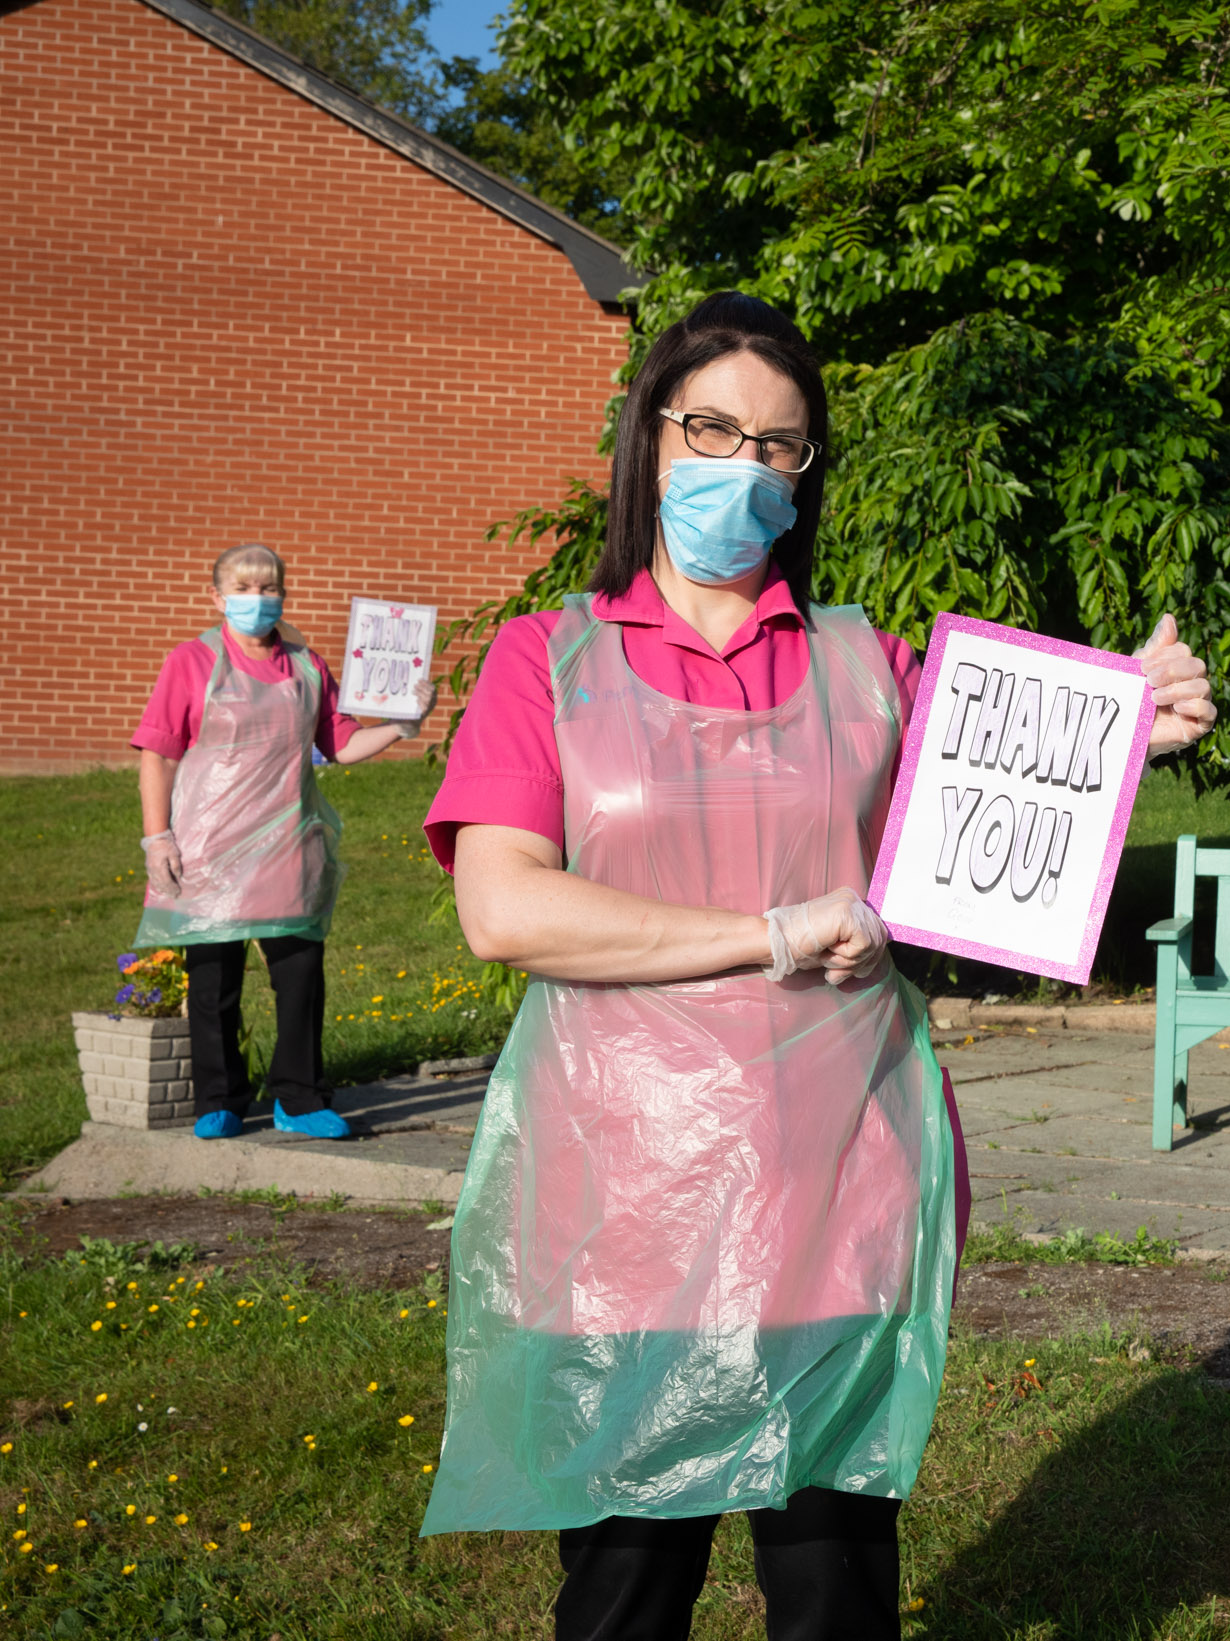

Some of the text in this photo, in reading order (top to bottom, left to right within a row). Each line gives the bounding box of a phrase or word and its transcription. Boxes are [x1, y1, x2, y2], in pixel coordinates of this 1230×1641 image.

[360, 613, 422, 655] THANK
[361, 657, 410, 696] YOU!
[941, 662, 1120, 793] THANK
[935, 786, 1072, 909] YOU!
